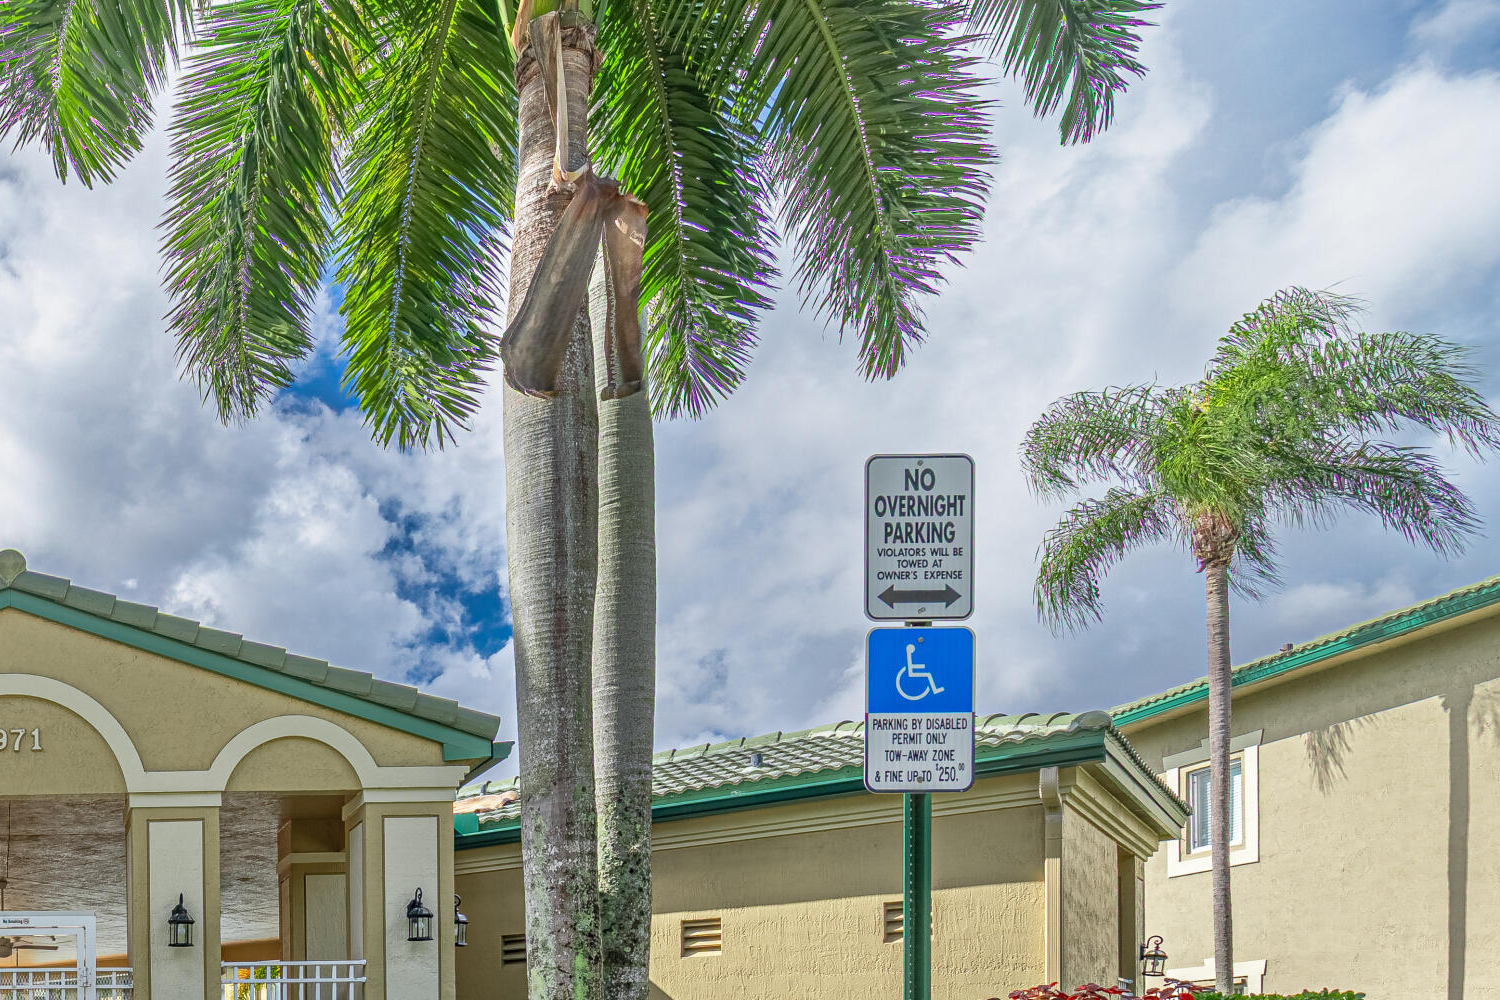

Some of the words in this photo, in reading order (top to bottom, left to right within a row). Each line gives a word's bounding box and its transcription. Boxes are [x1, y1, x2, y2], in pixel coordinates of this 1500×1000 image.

[904, 468, 936, 491] NO
[874, 494, 966, 518] OVERNIGHT
[884, 521, 956, 544] PARKING
[877, 548, 926, 557] VIOLATORS
[930, 548, 949, 556] WILL
[953, 548, 964, 556] BE
[897, 560, 928, 568] TOWED
[932, 560, 943, 568] AT
[877, 571, 918, 580] OWNER'S
[924, 570, 962, 580] EXPENSE
[872, 718, 908, 730] PARKING
[912, 718, 922, 730] BY
[926, 718, 968, 730] DISABLED
[892, 733, 923, 744] PERMIT
[926, 733, 948, 744] ONLY
[885, 750, 928, 762] TOW-AWAY
[932, 750, 956, 762] ZONE
[874, 770, 880, 782] &
[884, 770, 904, 782] FINE
[907, 770, 918, 782] UP
[922, 770, 932, 782] TO
